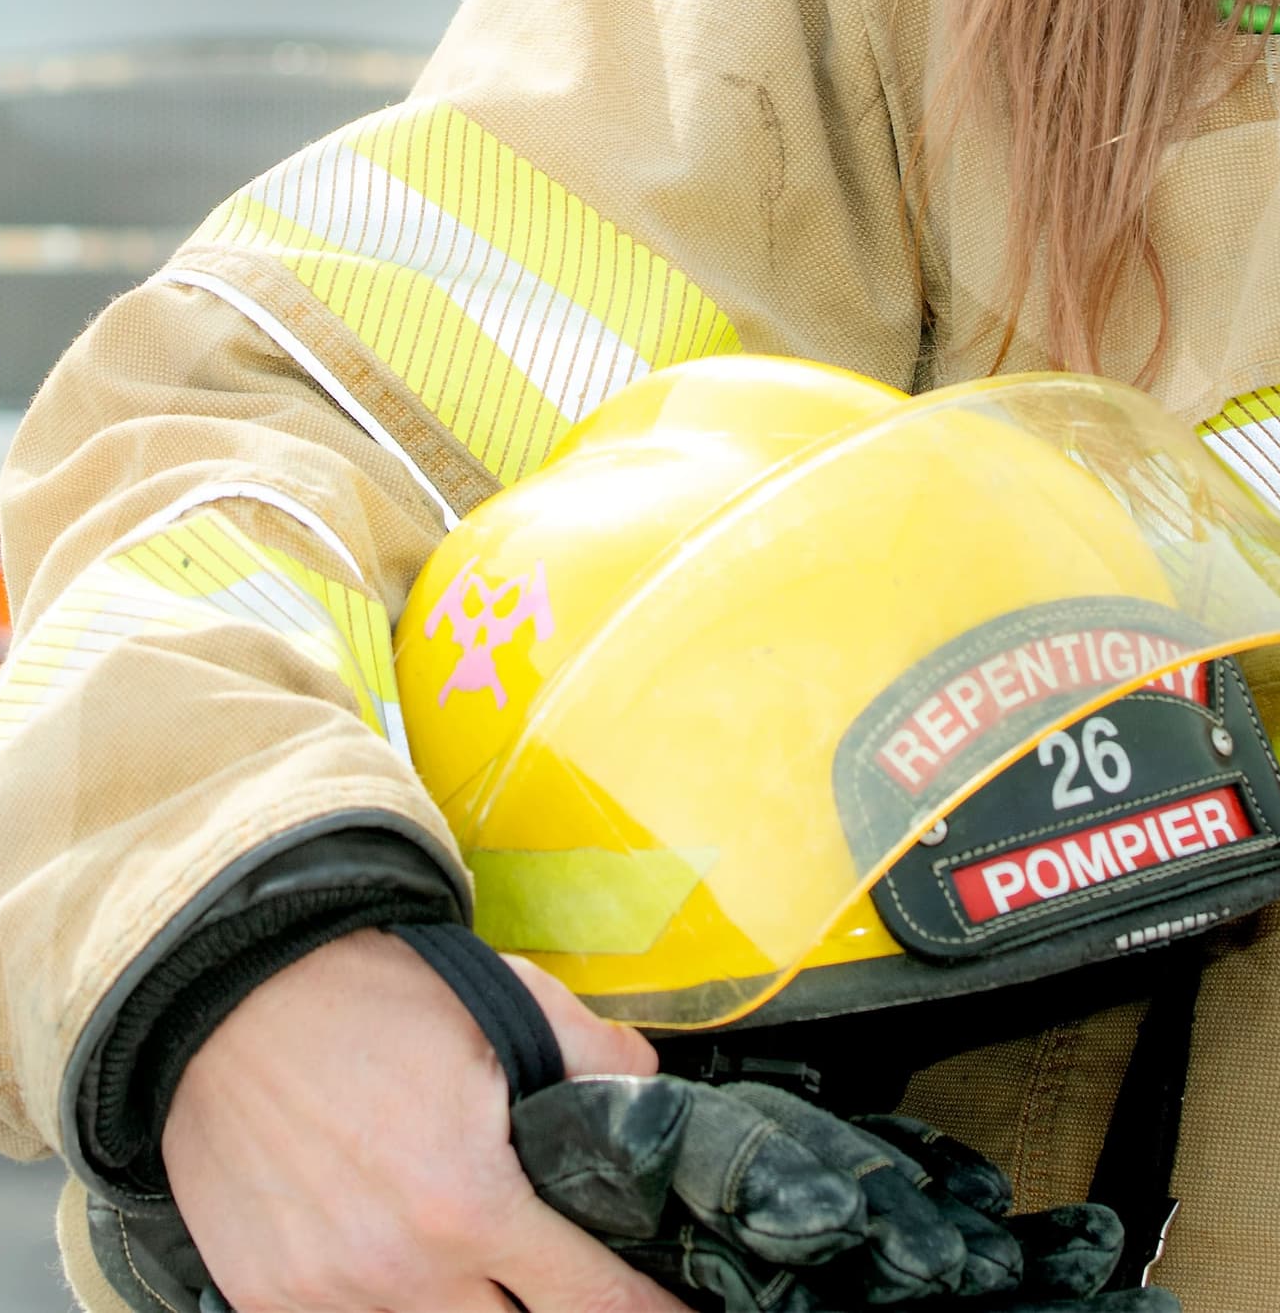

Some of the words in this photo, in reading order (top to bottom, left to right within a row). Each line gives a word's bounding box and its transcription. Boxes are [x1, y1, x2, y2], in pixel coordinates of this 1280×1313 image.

[881, 630, 1203, 786] REPENTIGNY
[1037, 717, 1132, 810] 26
[981, 797, 1236, 915] POMPIER
